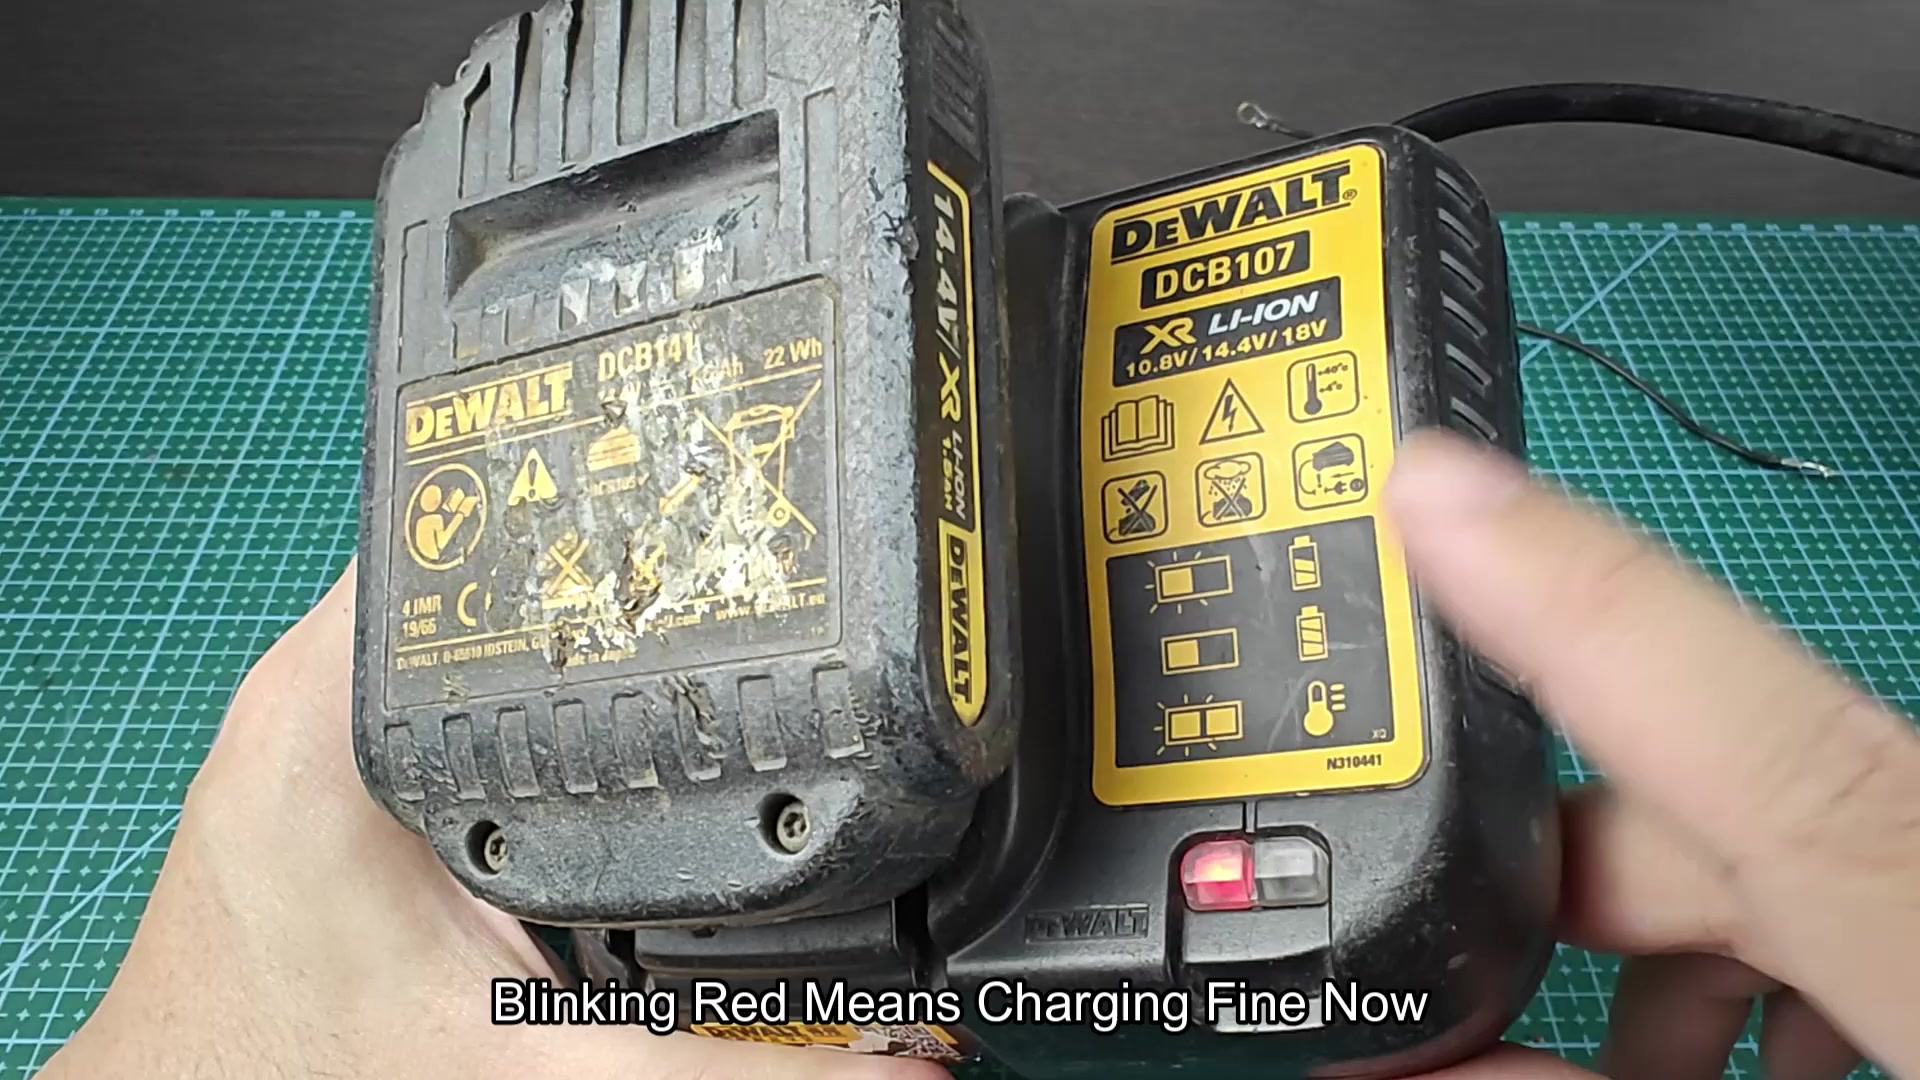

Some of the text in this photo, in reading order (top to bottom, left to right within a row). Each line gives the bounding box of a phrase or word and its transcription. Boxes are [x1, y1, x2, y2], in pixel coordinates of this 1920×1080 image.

[1155, 240, 1295, 300] DCB107
[1140, 291, 1318, 355] XR LI-ION
[763, 347, 785, 370] 22
[789, 336, 823, 363] Wh
[1326, 752, 1382, 771] N310441
